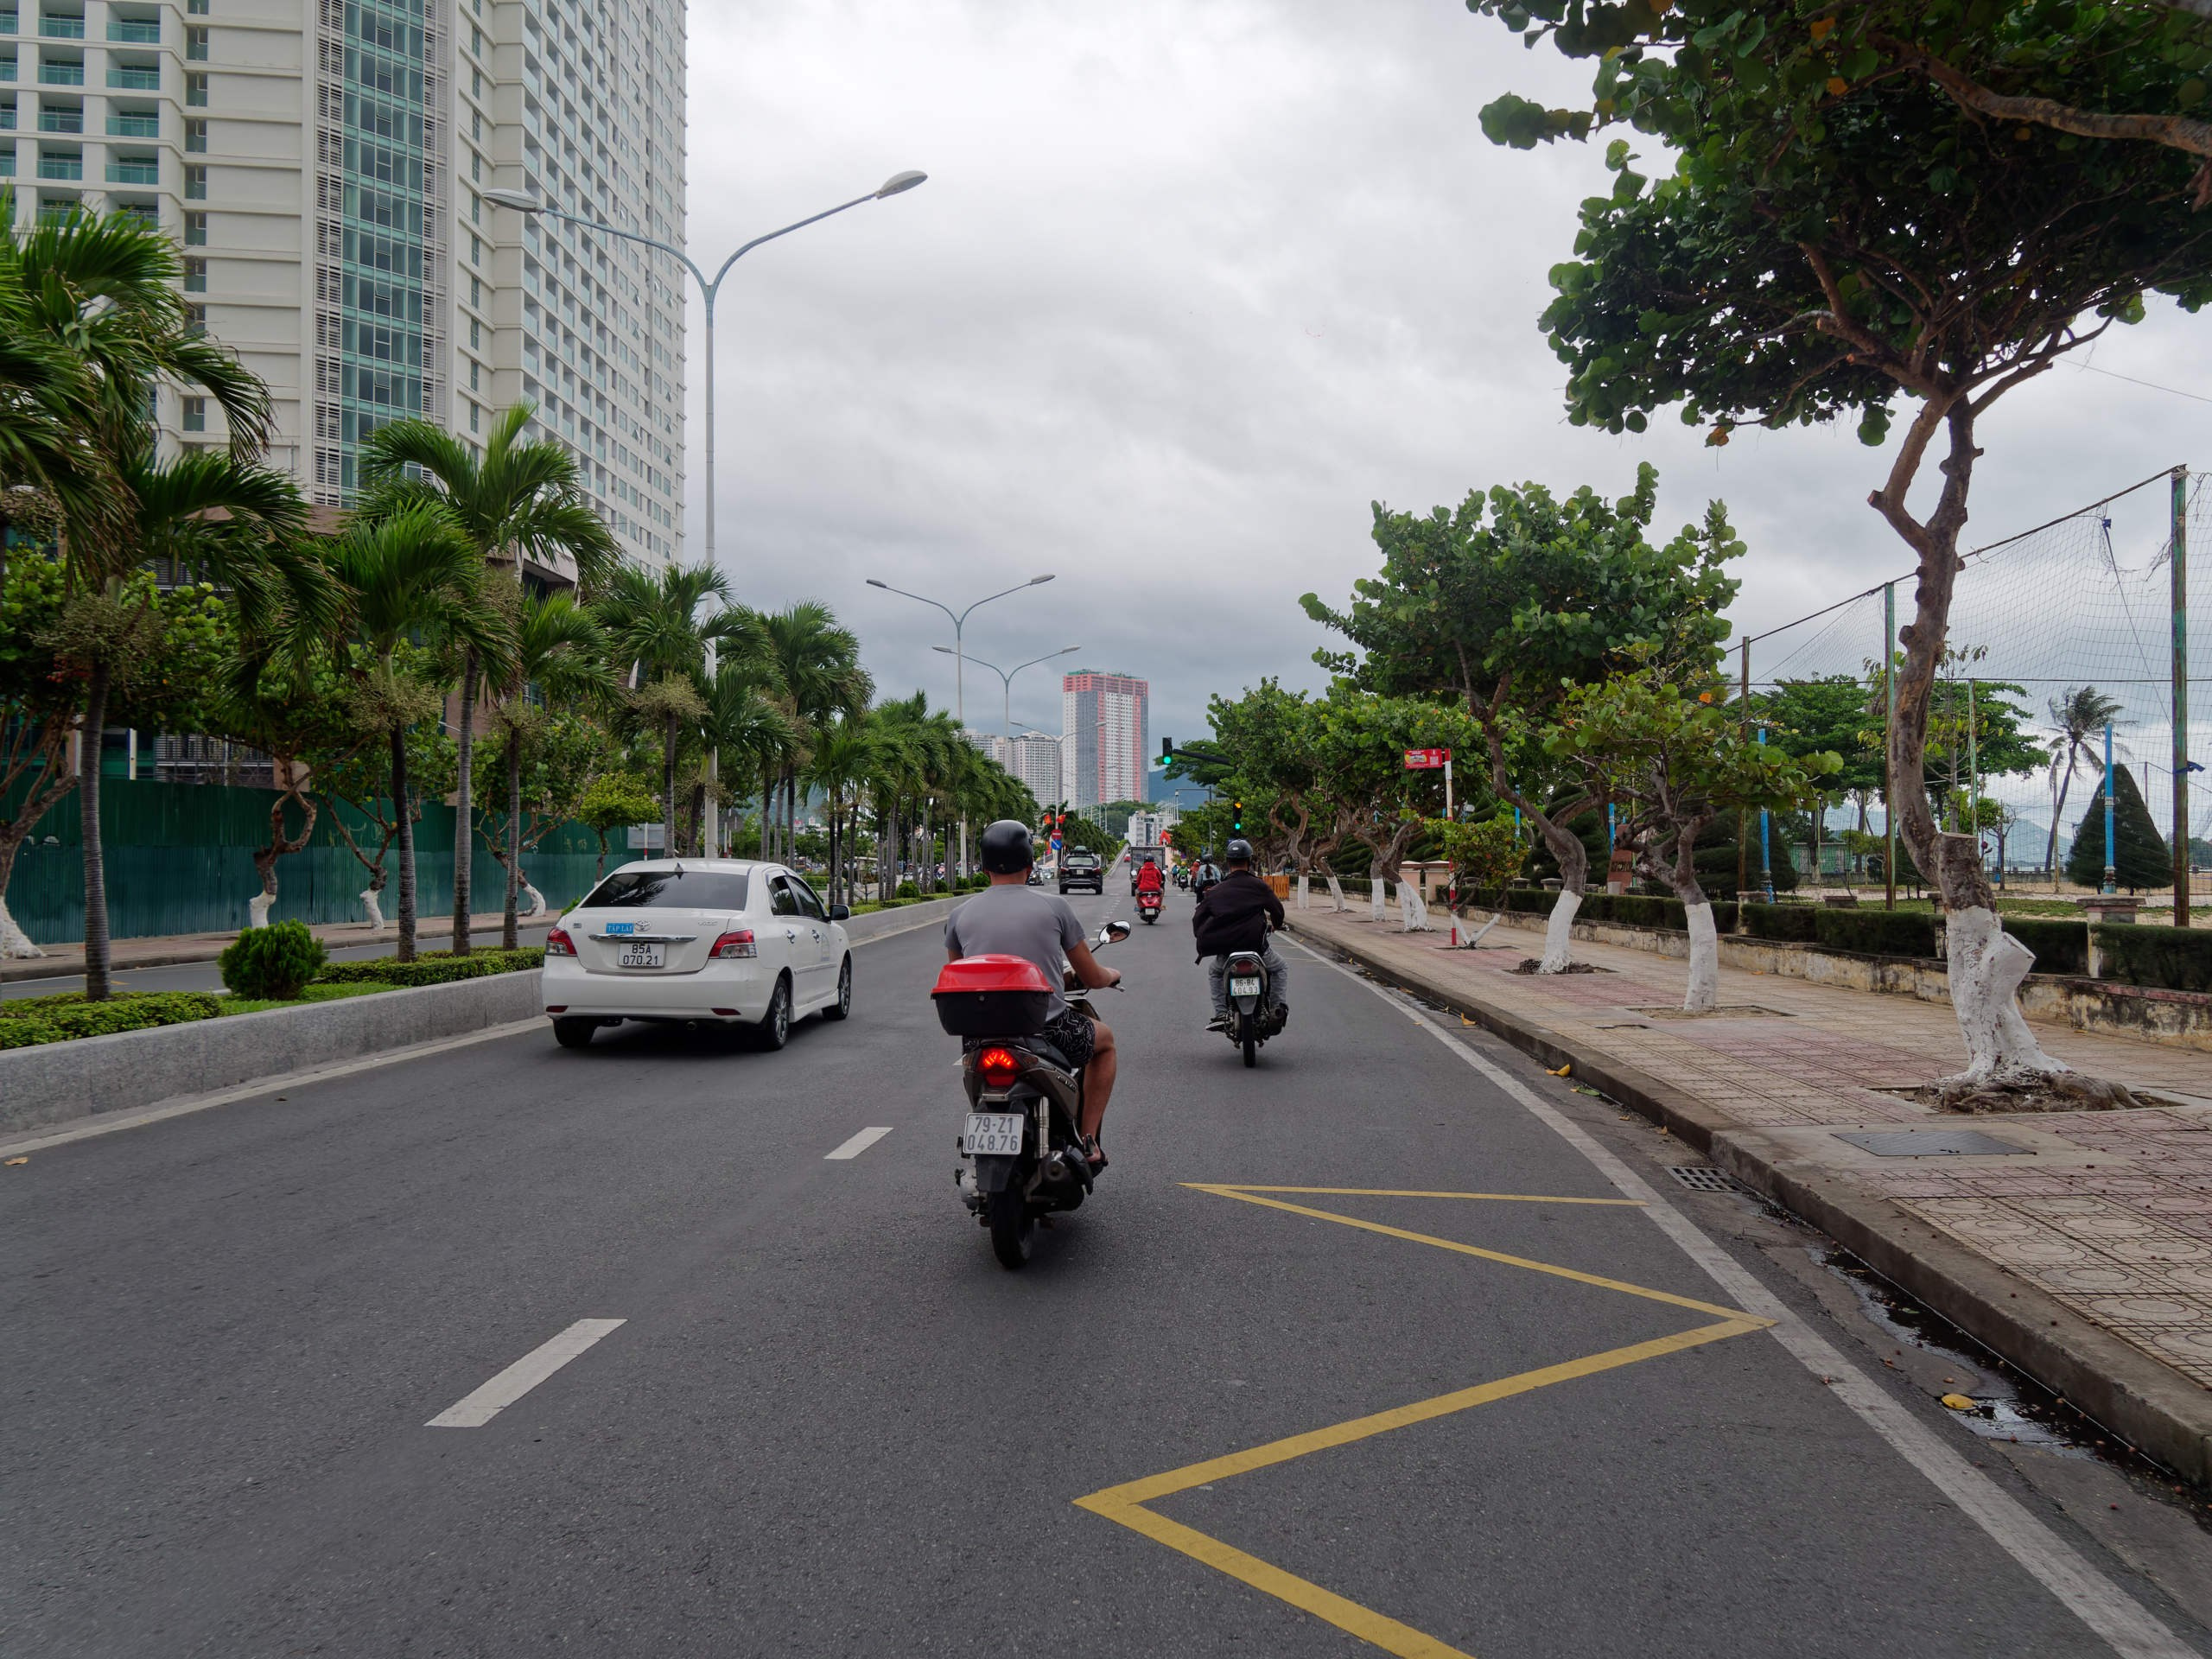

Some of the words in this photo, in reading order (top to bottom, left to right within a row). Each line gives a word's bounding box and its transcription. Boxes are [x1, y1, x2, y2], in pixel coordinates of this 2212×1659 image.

[632, 944, 652, 955] 85A
[623, 955, 658, 965] 070.21
[975, 1116, 1013, 1133] 79-Z1
[967, 1135, 1018, 1151] 048.76
